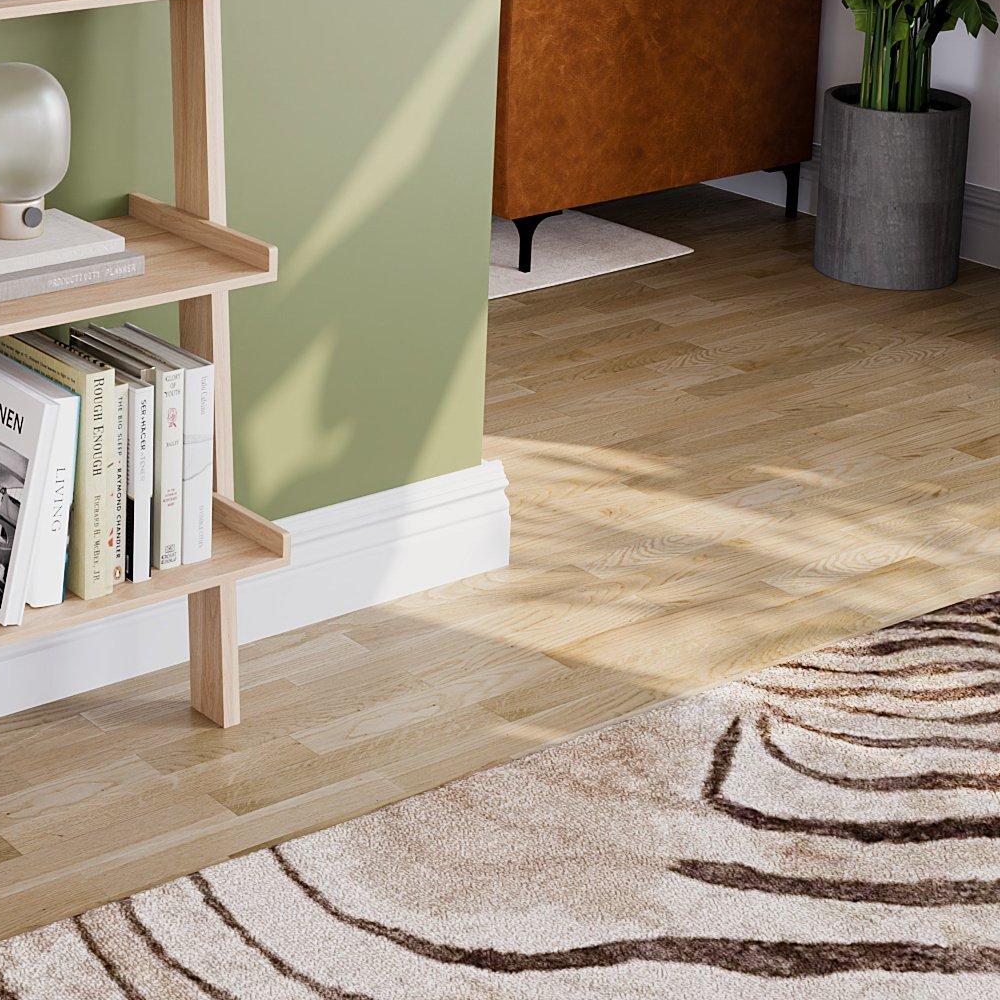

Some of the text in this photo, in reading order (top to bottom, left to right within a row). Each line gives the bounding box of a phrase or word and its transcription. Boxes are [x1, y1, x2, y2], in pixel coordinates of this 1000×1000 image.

[92, 377, 105, 476] ROUGH ENOUGH
[52, 467, 66, 533] LIVING
[93, 495, 102, 528] RICHARD
